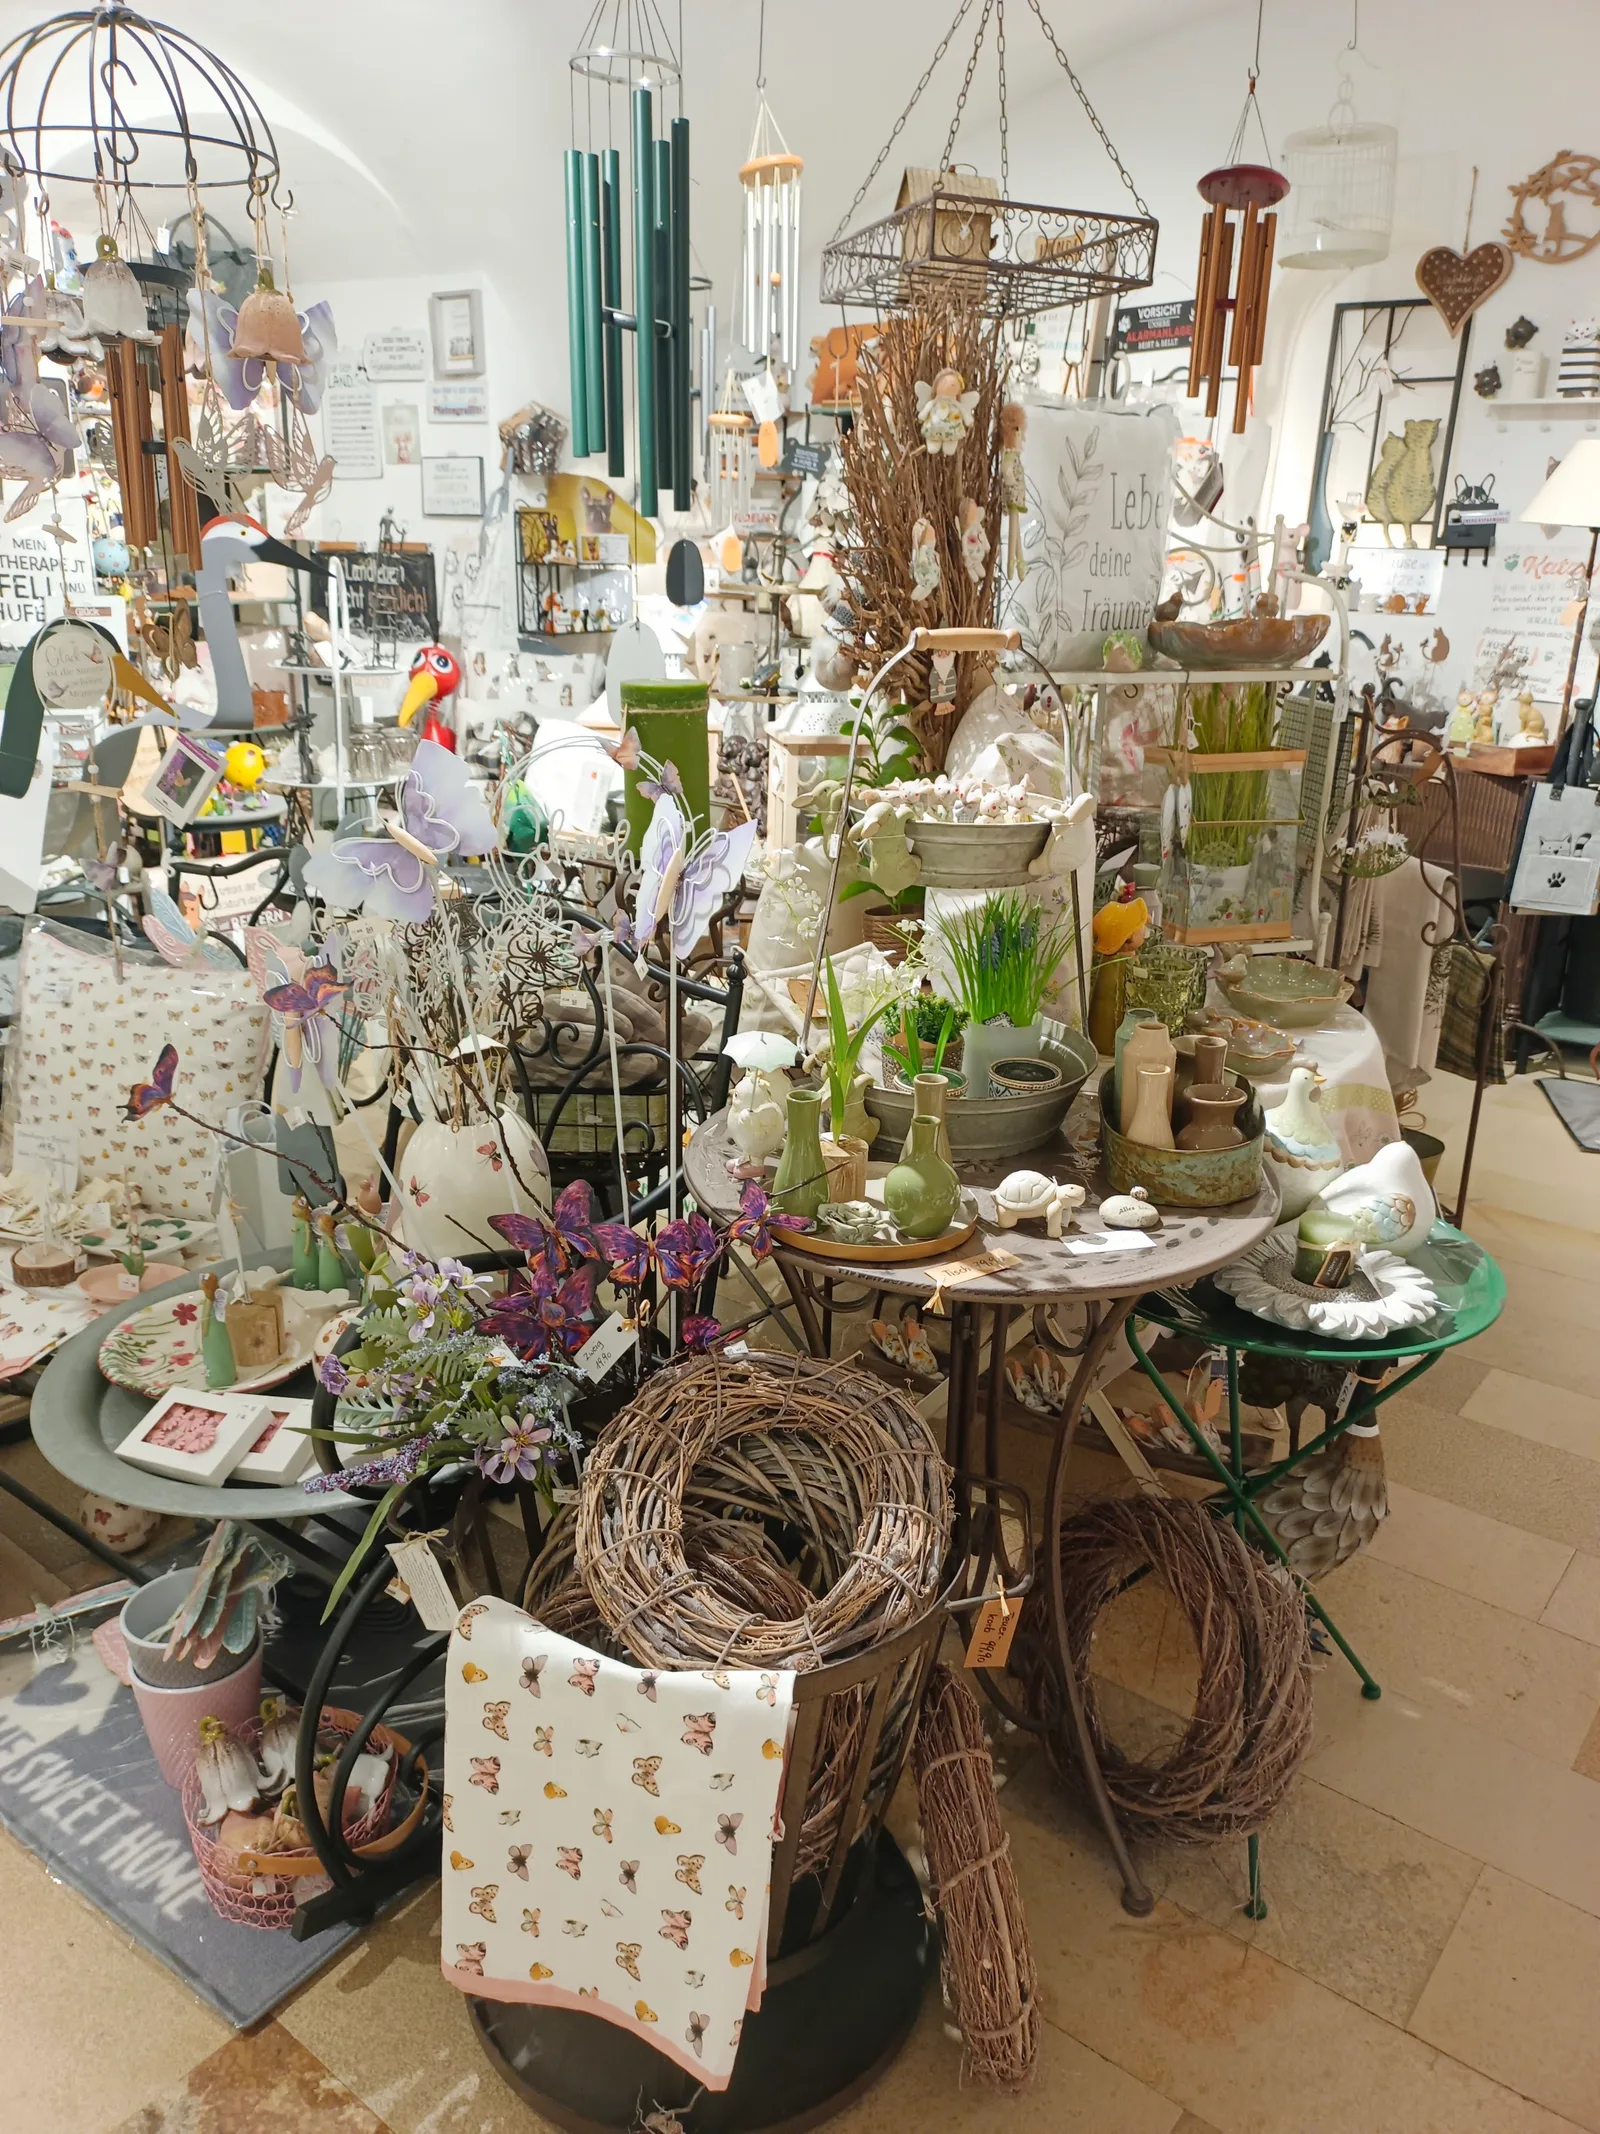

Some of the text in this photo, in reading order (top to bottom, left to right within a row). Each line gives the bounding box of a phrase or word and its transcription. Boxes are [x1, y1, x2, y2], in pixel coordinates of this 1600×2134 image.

[1138, 304, 1182, 319] VORSICHT
[1126, 325, 1193, 343] ALARMANLAGE
[1110, 472, 1165, 530] Lebe
[12, 538, 47, 551] MEIN
[1089, 542, 1132, 577] deine
[1081, 590, 1150, 632] Träume
[1118, 1206, 1135, 1215] Alles
[943, 1265, 972, 1277] Tisch
[583, 1341, 605, 1361] Zweig
[1, 1751, 142, 1847] SWEET
[98, 1821, 206, 1922] HOME
